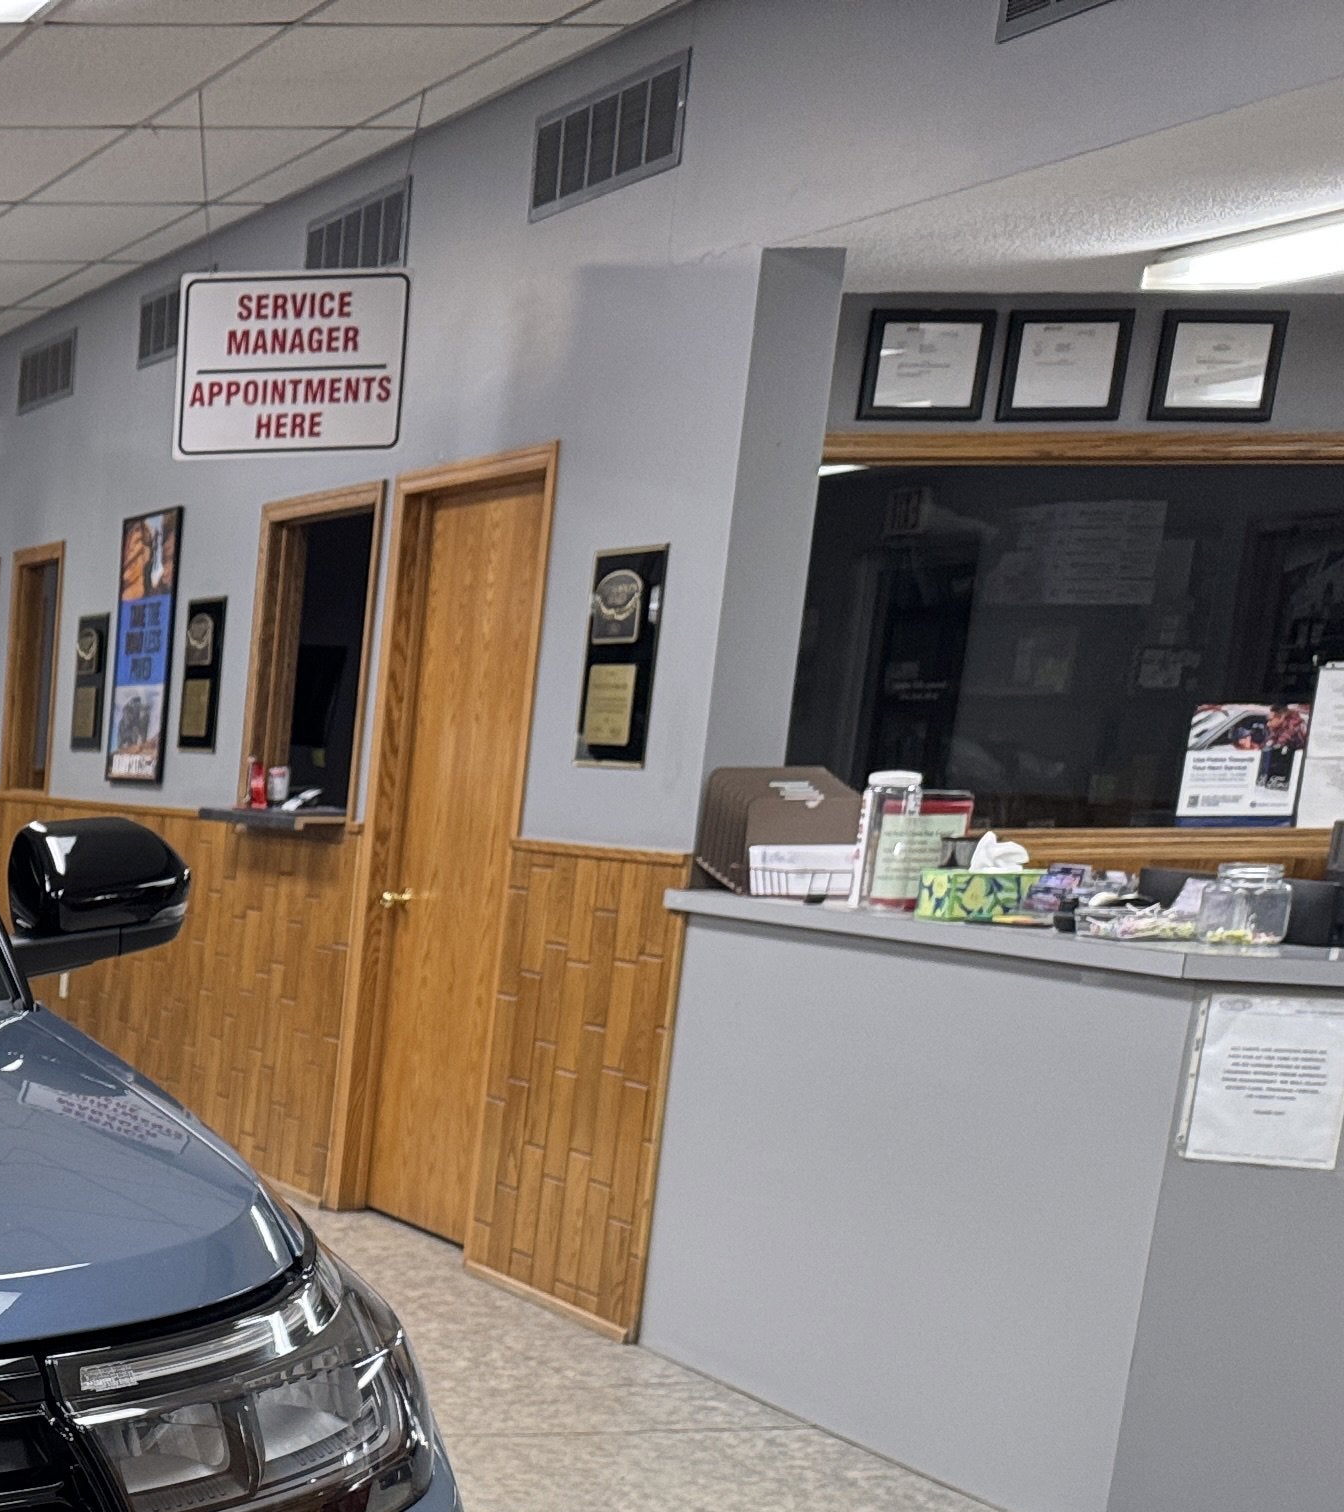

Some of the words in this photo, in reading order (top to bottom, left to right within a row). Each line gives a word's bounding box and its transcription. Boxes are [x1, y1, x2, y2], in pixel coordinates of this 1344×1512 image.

[237, 291, 353, 321] SERVICE
[226, 326, 360, 356] MANAGER
[189, 375, 392, 408] APPOINTMENTS
[255, 412, 322, 439] HERE
